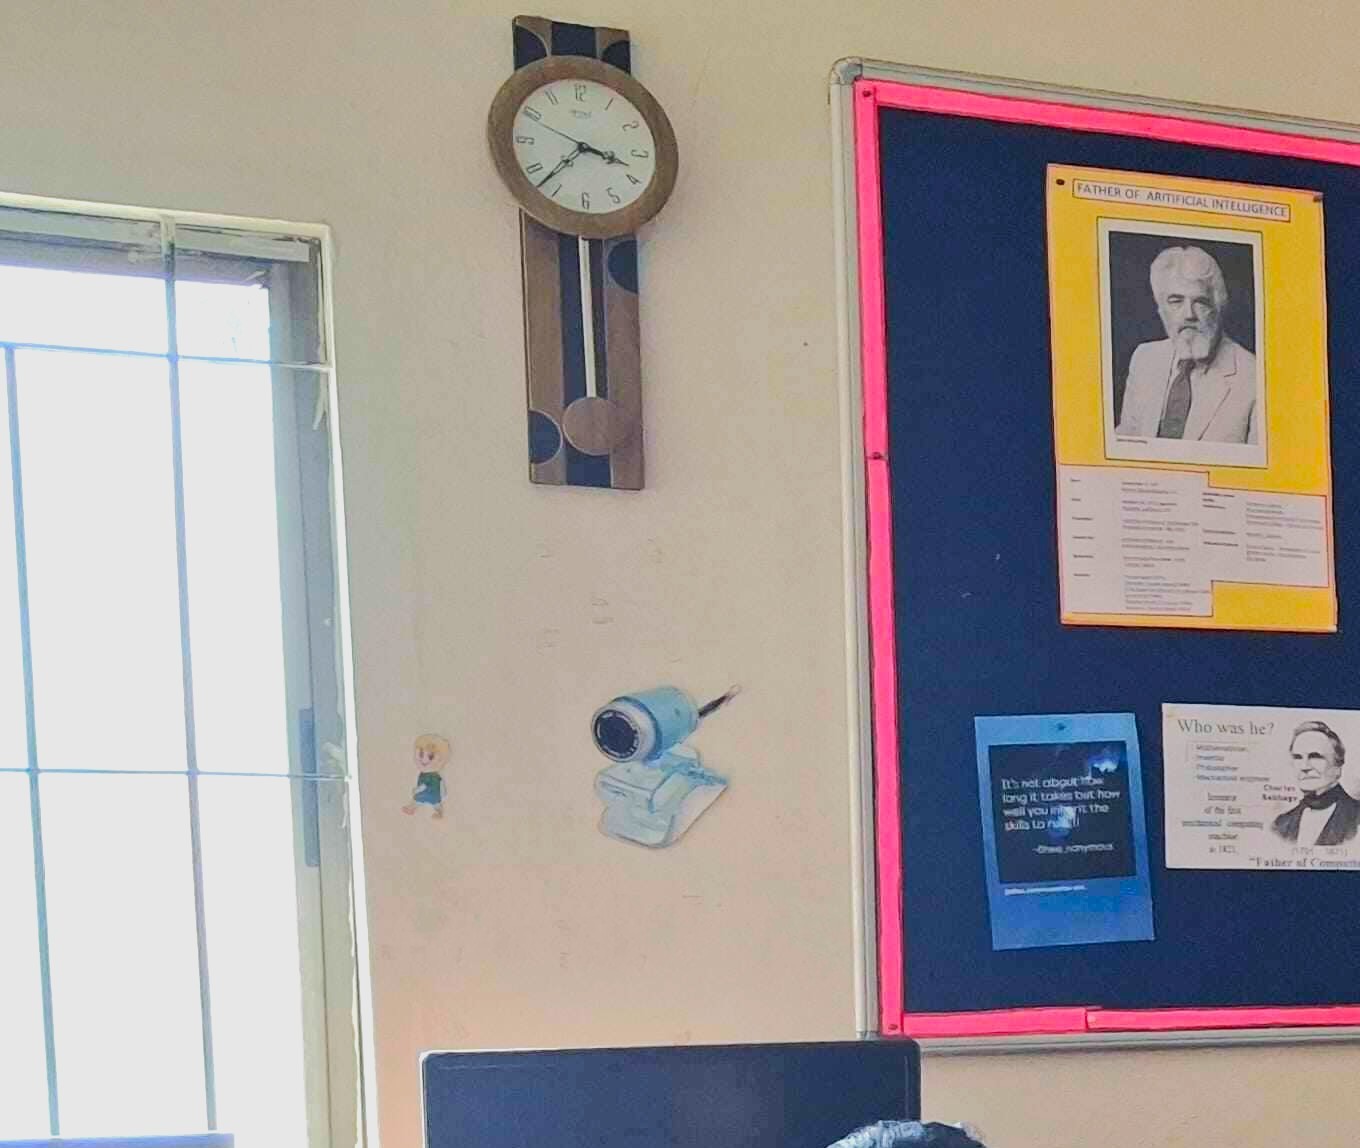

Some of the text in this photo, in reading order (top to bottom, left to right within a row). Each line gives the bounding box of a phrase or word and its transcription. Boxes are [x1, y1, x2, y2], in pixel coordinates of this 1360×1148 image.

[574, 84, 586, 101] 12
[622, 120, 639, 131] 2
[626, 175, 642, 184] 4
[582, 192, 589, 209] 6
[606, 187, 620, 203] 5
[1077, 183, 1120, 198] FATHER
[1125, 190, 1138, 199] OF
[1212, 200, 1287, 217] INTELLIGENCE
[1178, 719, 1274, 736] Who was he?
[1043, 777, 1078, 790] about
[1003, 792, 1027, 805] long
[1030, 792, 1038, 802] it
[1075, 790, 1095, 800] but
[1097, 789, 1120, 799] how
[1027, 807, 1048, 817] you
[1089, 803, 1109, 813] the
